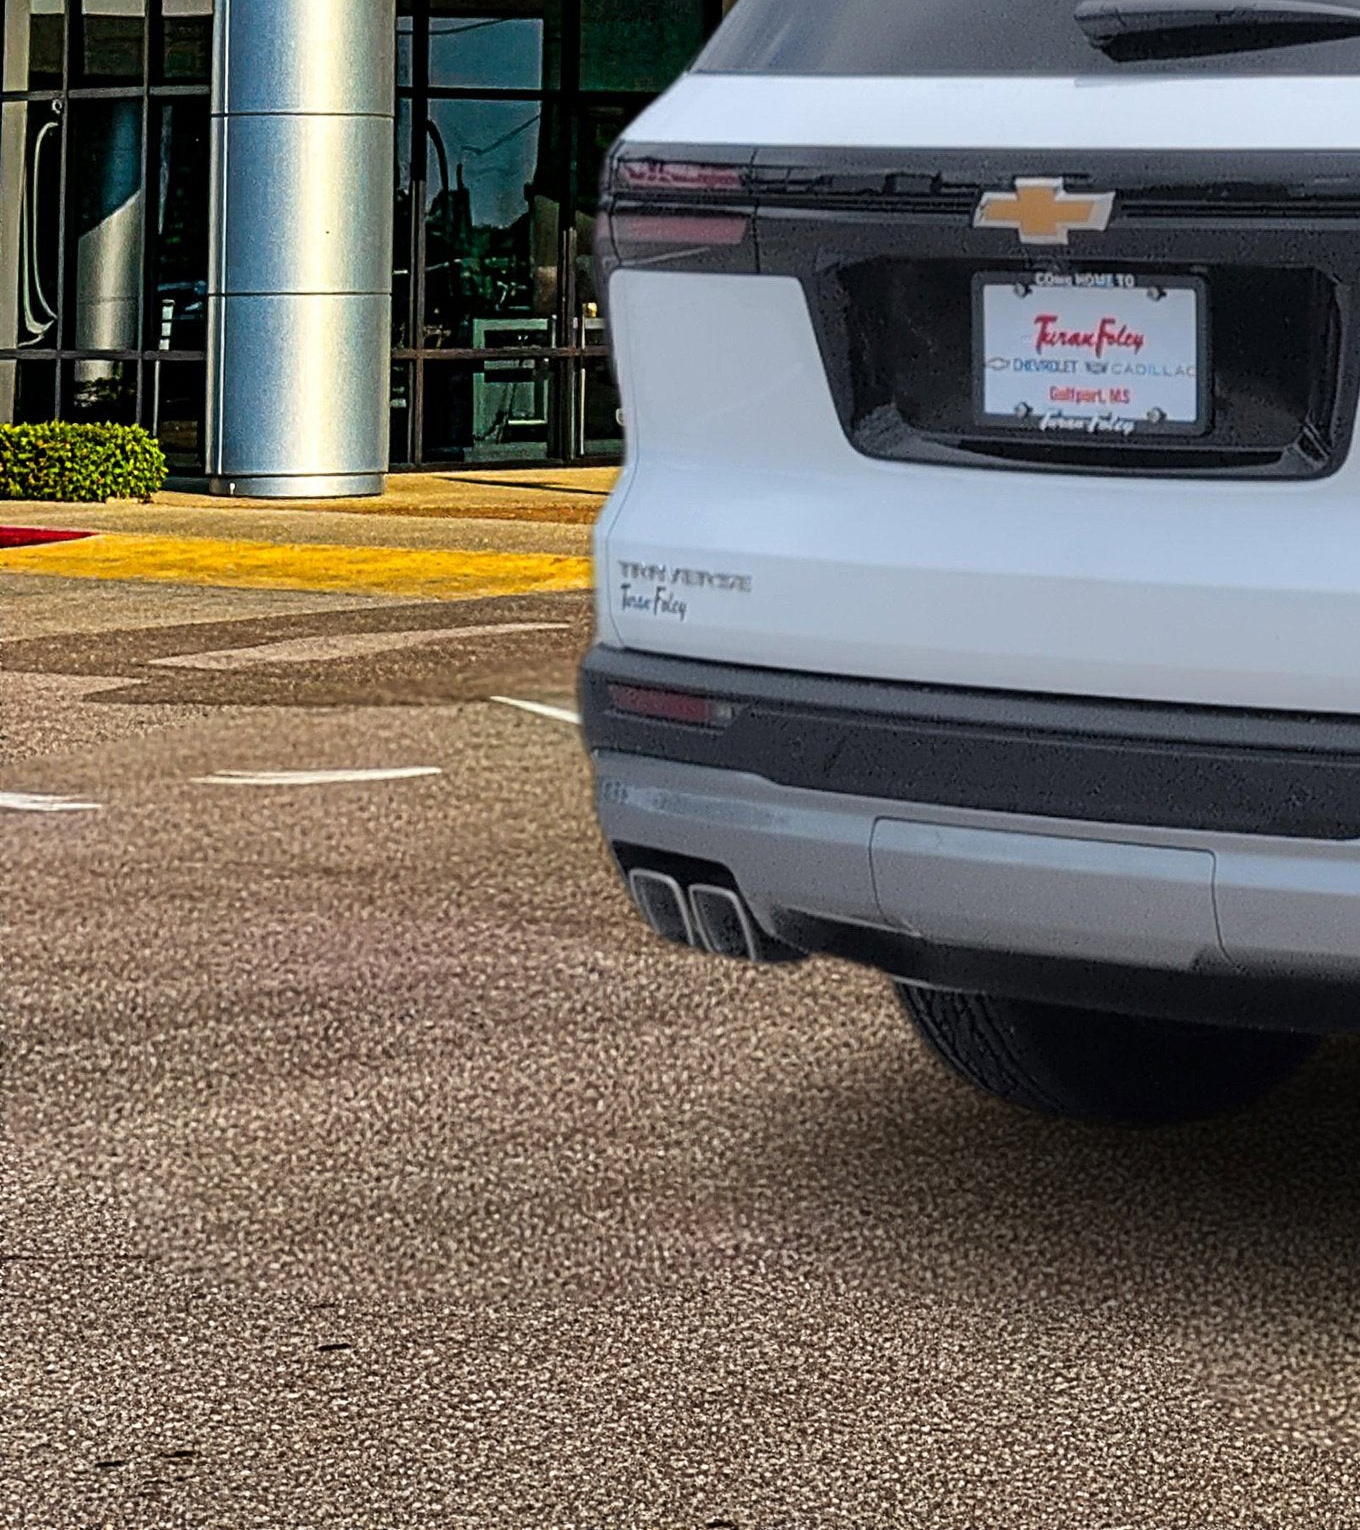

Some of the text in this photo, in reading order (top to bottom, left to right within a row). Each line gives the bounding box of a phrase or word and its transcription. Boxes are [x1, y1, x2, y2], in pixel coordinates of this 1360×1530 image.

[1116, 274, 1135, 287] TO
[1034, 315, 1145, 359] Turan Foley
[1013, 358, 1196, 377] CHEVROLET CADILLAC
[1109, 387, 1130, 404] MS
